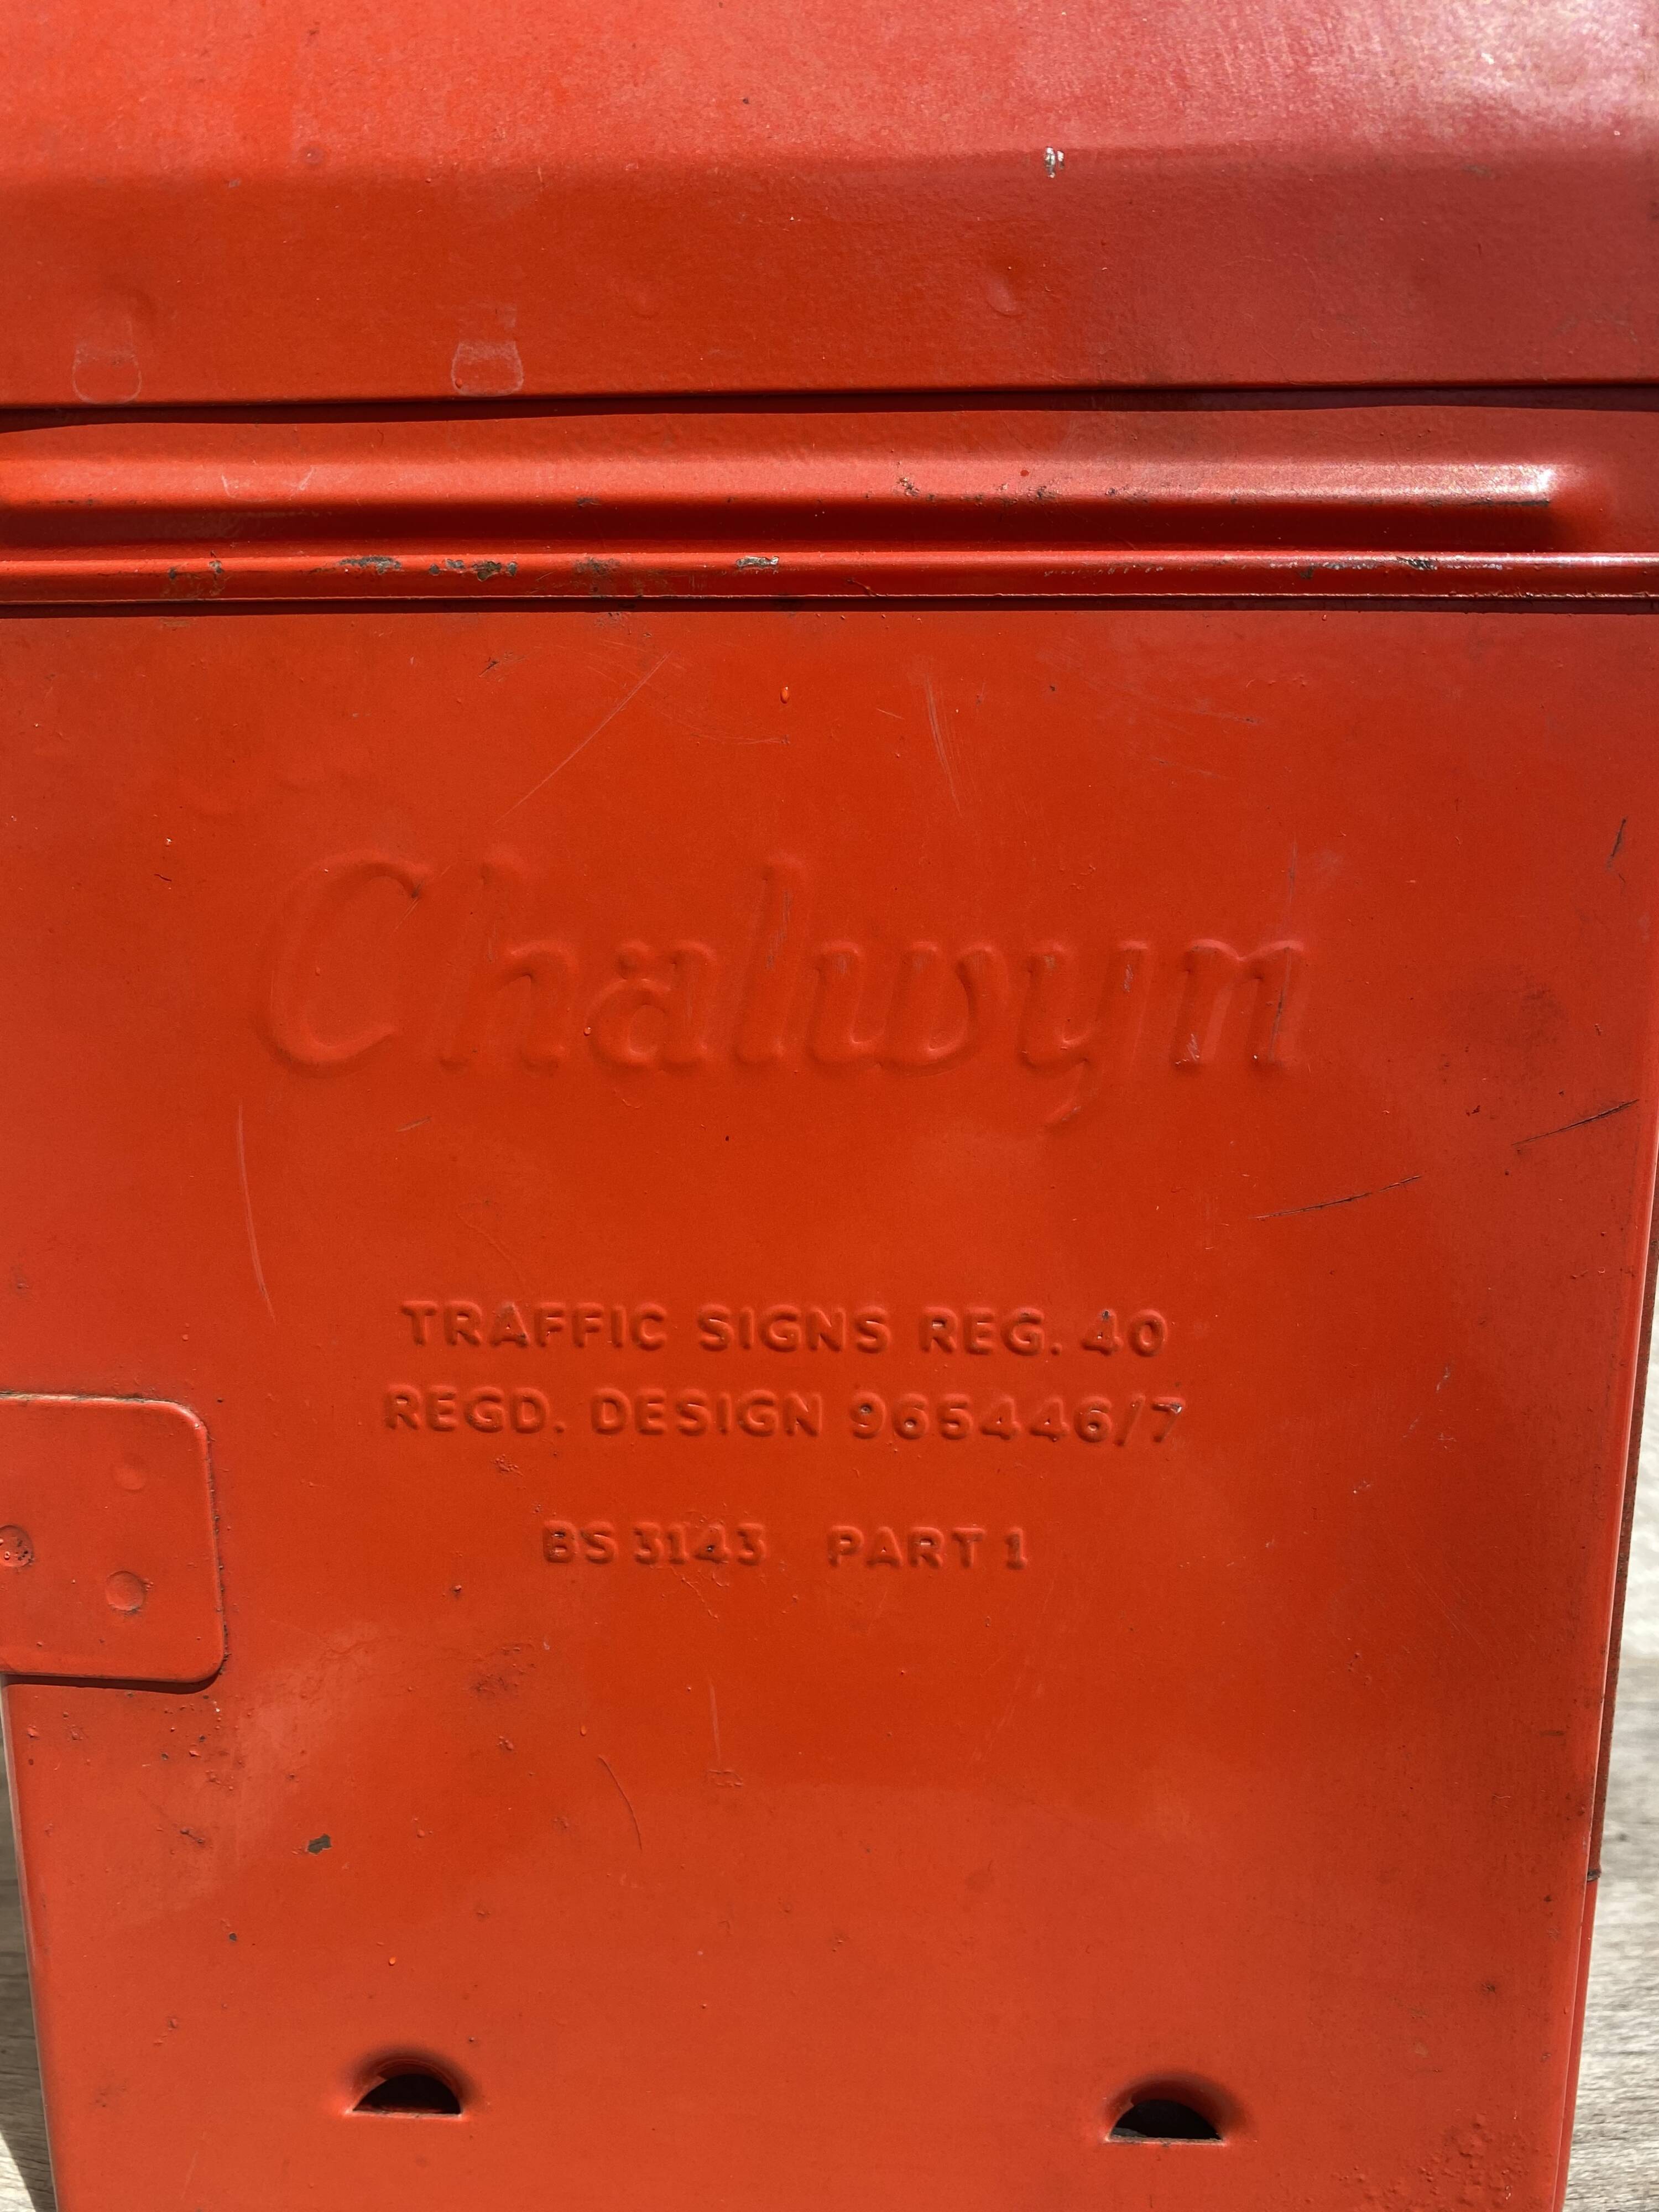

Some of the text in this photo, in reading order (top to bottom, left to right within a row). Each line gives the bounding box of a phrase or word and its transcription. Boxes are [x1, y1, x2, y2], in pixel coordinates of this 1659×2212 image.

[264, 845, 1310, 1128] Chalwyn
[400, 1298, 1169, 1357] TRAFFIC SIGNS REG. 40
[386, 1383, 1187, 1447] REGD. DESIGN 965446/7
[543, 1519, 1027, 1571] BS 3143 PART 1
